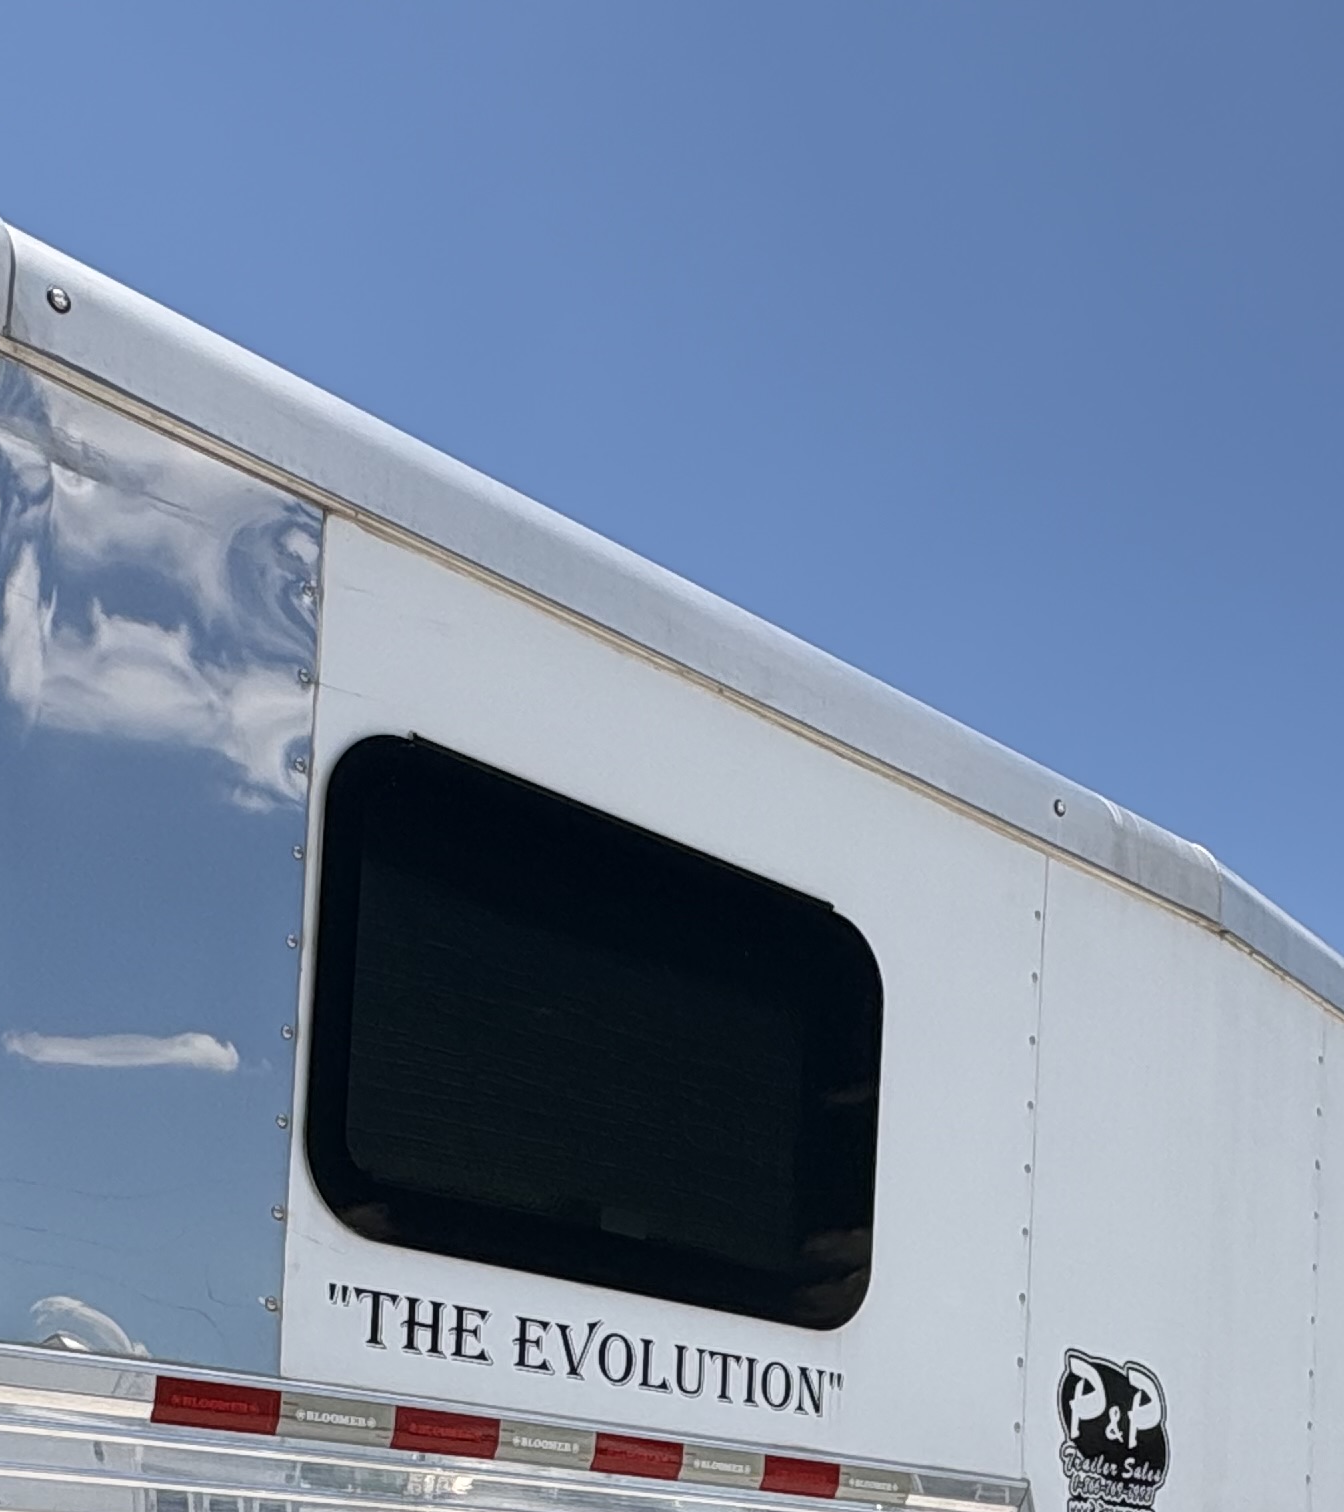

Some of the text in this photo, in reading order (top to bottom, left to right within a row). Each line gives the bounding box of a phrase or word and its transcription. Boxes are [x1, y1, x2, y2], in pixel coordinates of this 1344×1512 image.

[327, 1282, 845, 1418] "THE EVOLUTION"
[306, 1410, 367, 1428] BLOOMER
[1063, 1447, 1161, 1482] Trailer Sales
